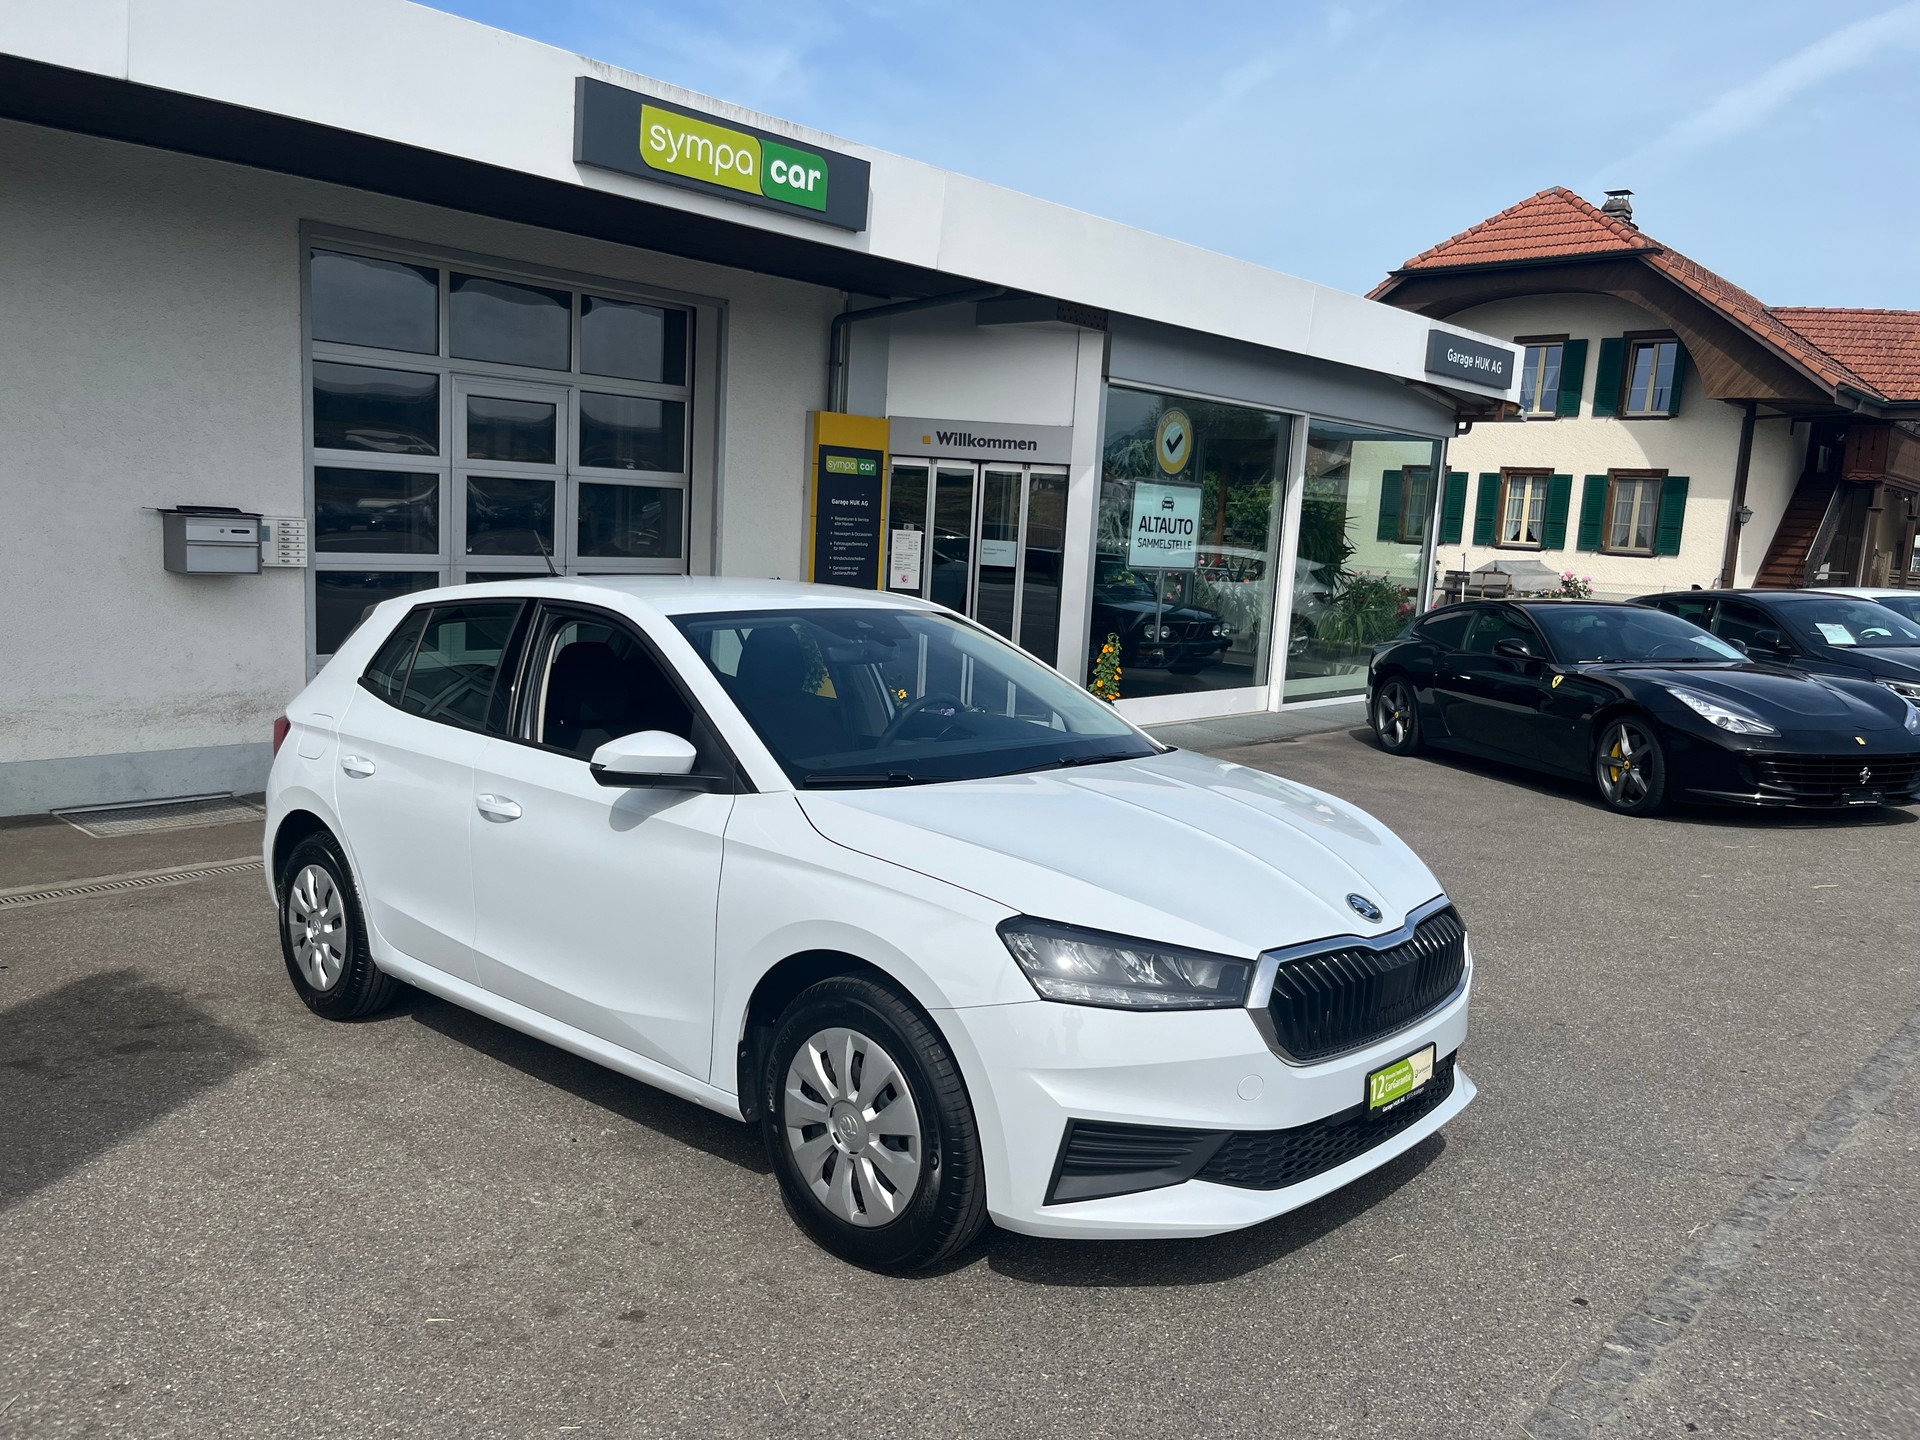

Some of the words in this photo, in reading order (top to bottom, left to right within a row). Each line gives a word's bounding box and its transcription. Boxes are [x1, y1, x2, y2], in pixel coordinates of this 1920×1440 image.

[650, 124, 753, 176] sympa
[770, 159, 821, 192] car
[1447, 348, 1473, 368] Garage
[1475, 356, 1490, 371] HUK
[1491, 360, 1502, 374] AG
[936, 430, 1038, 451] Willkommen
[828, 460, 856, 471] sympa
[860, 463, 875, 471] car
[831, 498, 849, 506] Garage
[1138, 515, 1194, 535] ALTAUTO
[1137, 537, 1192, 550] SAMMELSTELLE
[1371, 1074, 1385, 1102] 12
